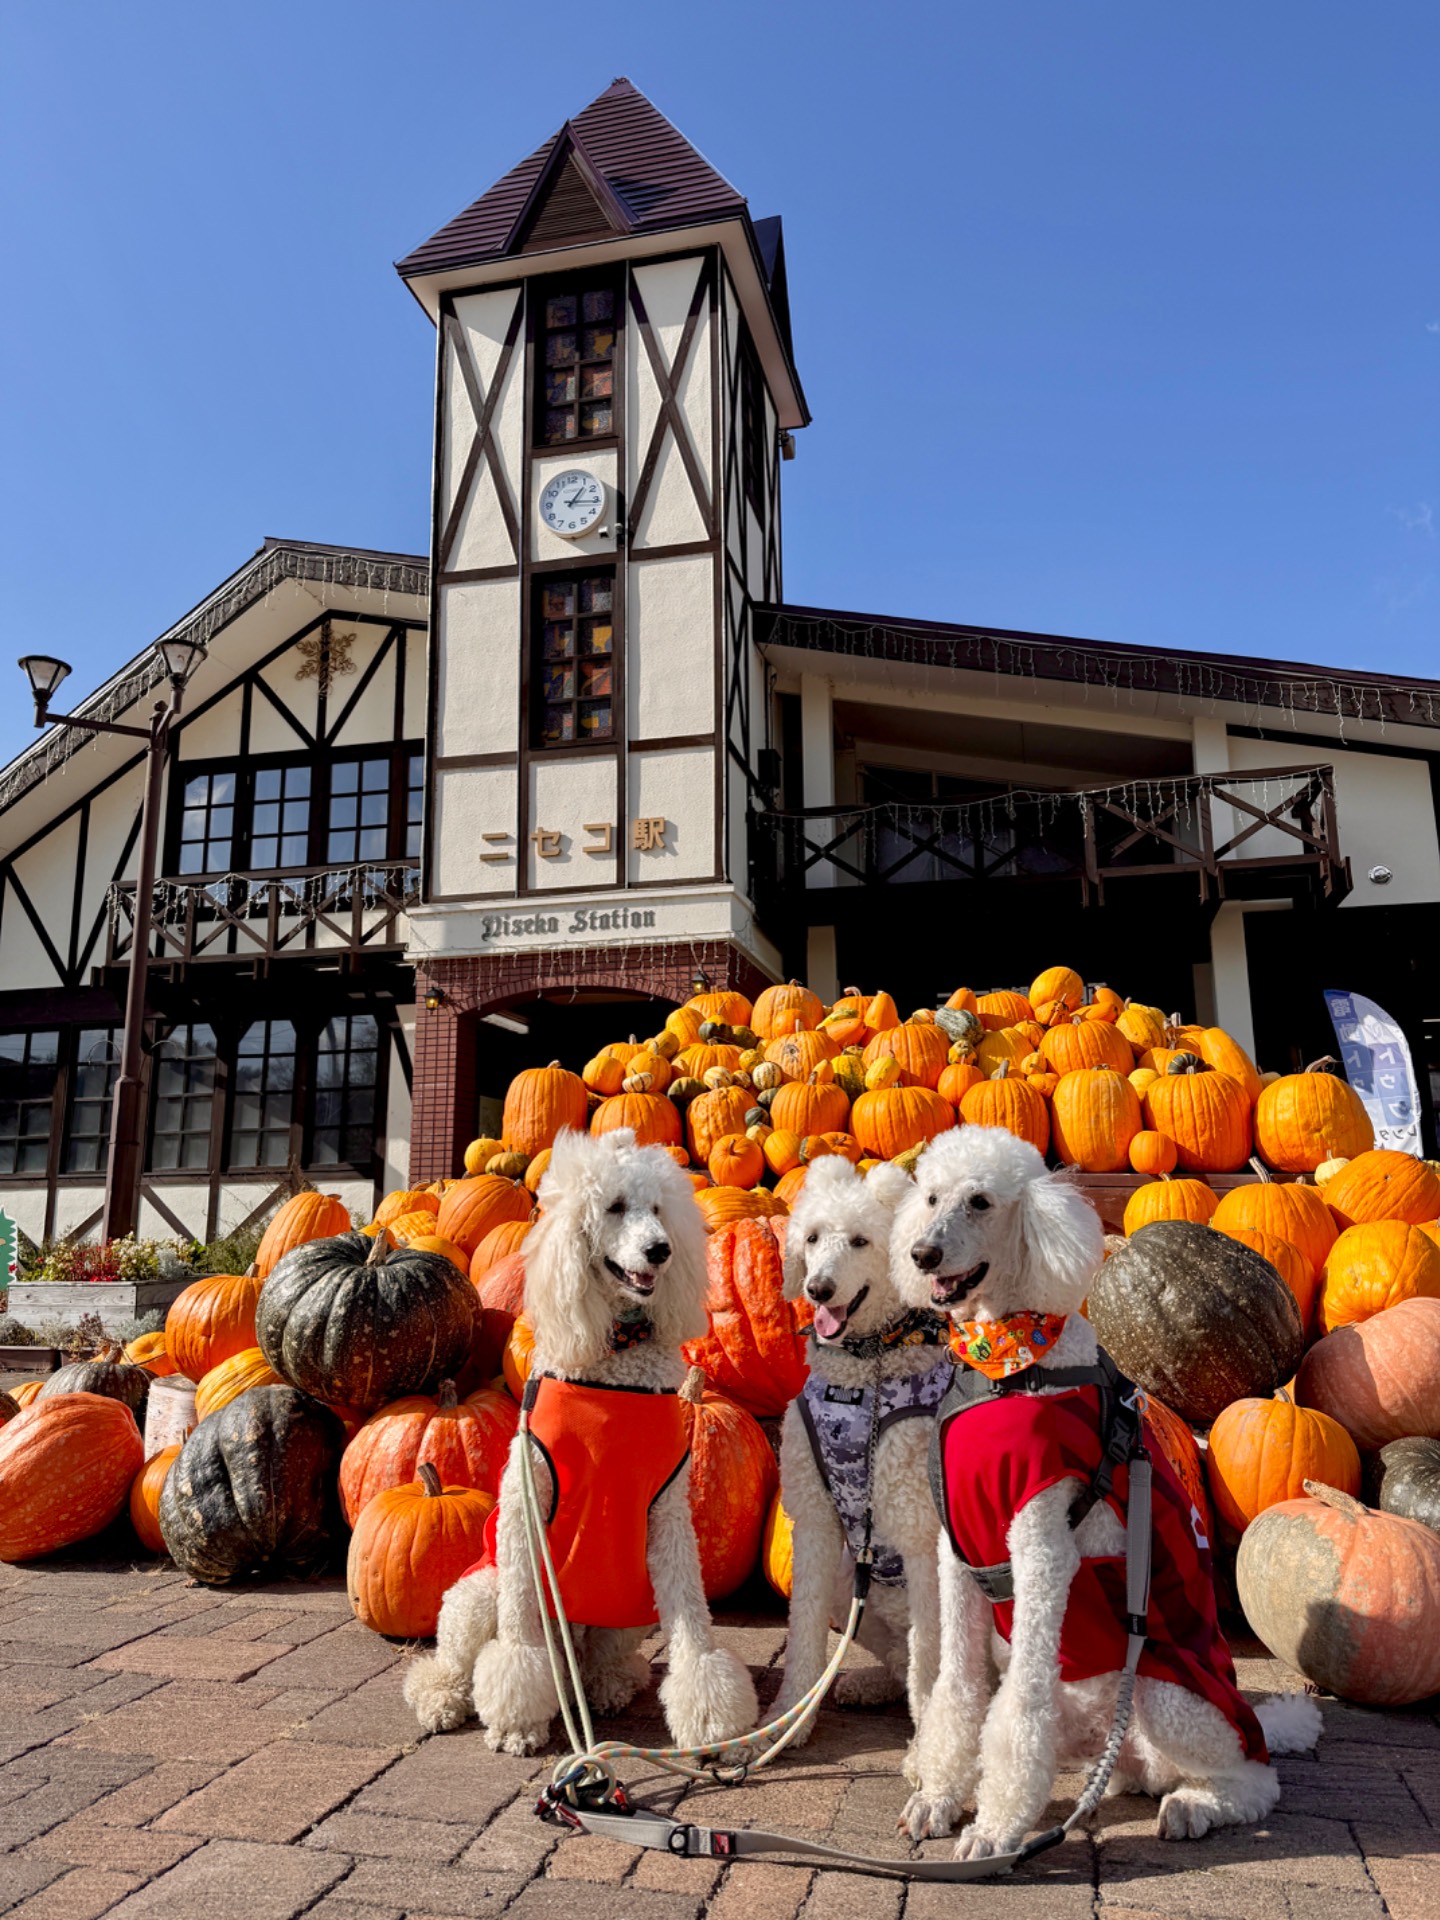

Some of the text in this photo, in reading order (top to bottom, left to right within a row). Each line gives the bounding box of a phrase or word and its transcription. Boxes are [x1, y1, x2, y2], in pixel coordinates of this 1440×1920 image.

[556, 480, 566, 488] 11
[567, 476, 578, 484] 12
[480, 816, 666, 861] ニセコ駅
[481, 907, 656, 941] Niseko Station
